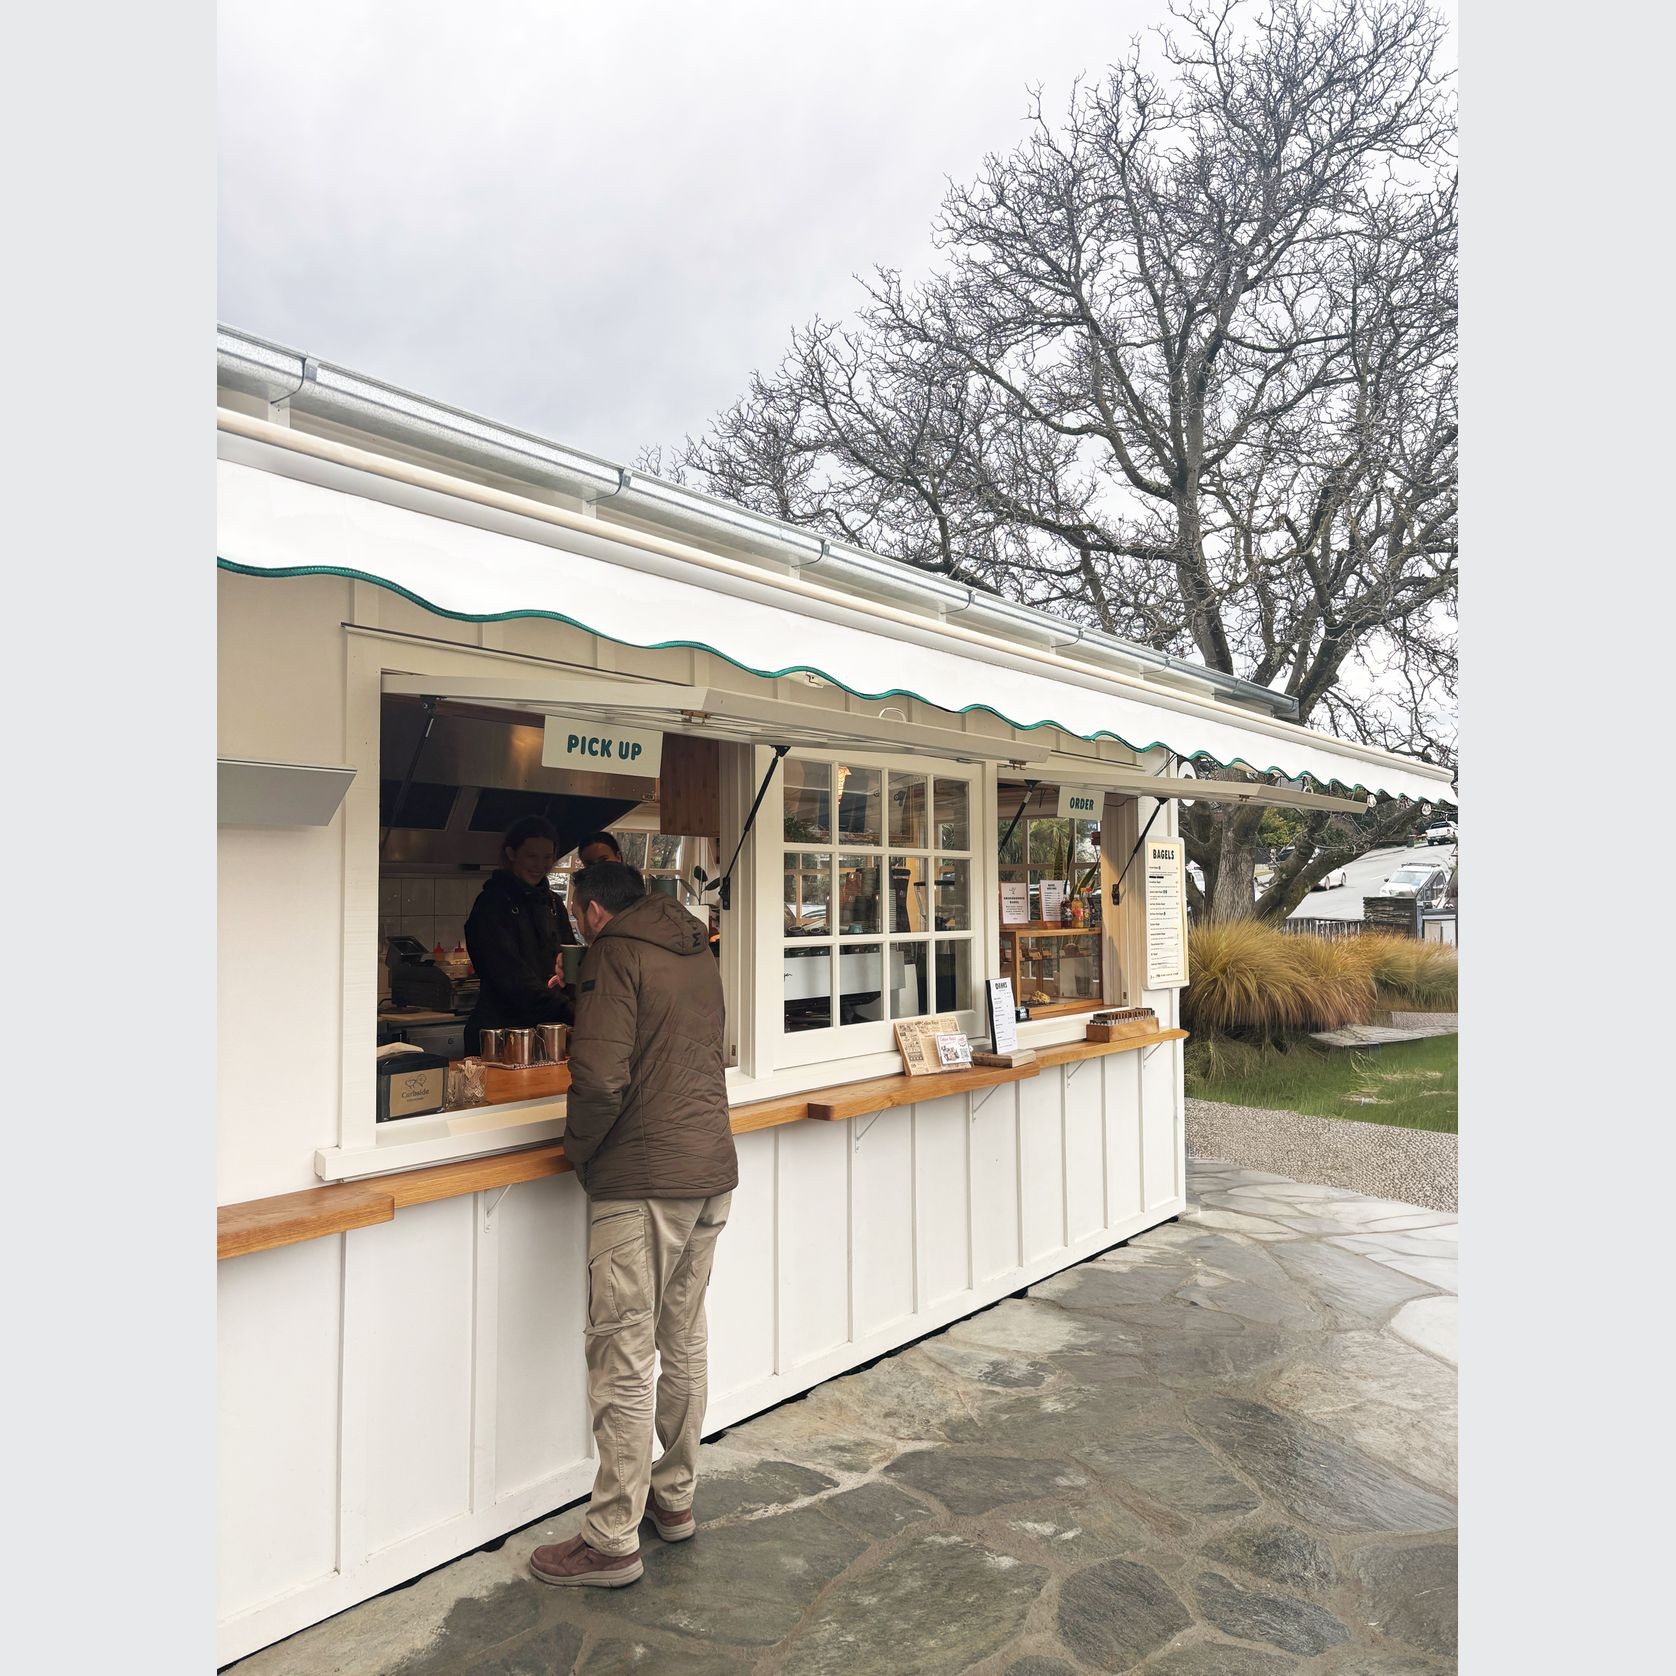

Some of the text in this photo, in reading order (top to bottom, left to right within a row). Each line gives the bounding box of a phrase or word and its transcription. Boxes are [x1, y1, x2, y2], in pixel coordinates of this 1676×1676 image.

[567, 734, 642, 760] PICK UP
[1070, 797, 1094, 810] ORDER
[1153, 849, 1175, 860] BAGELS
